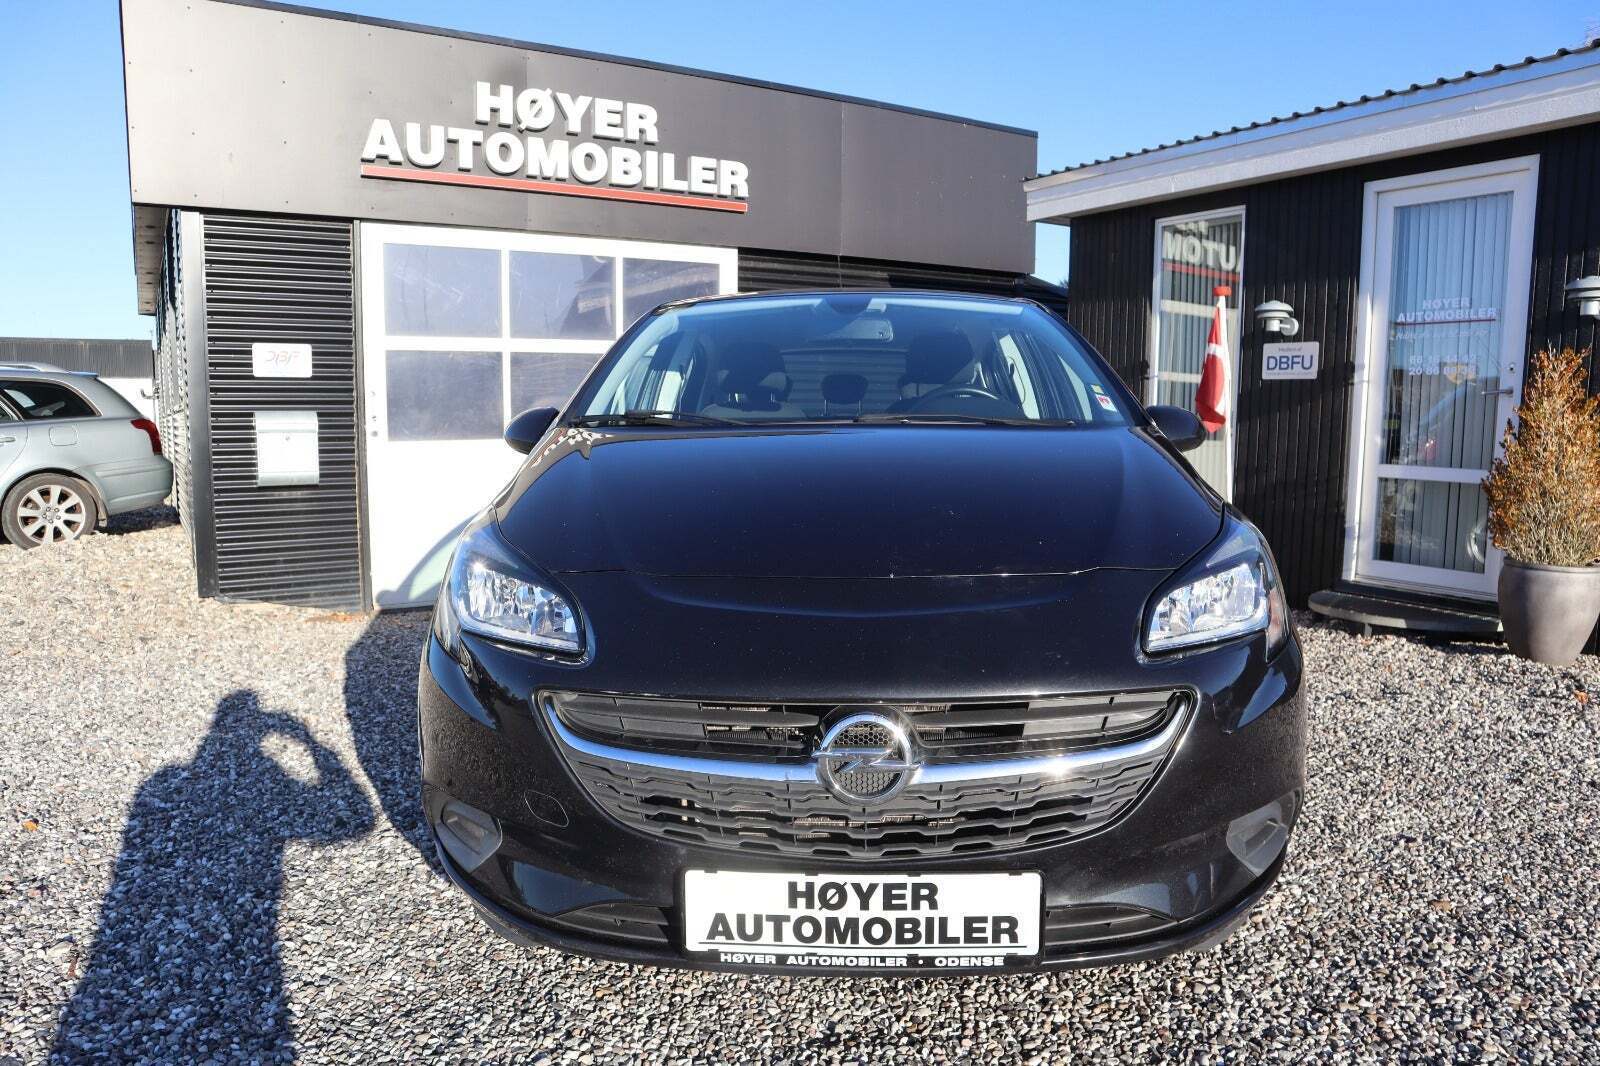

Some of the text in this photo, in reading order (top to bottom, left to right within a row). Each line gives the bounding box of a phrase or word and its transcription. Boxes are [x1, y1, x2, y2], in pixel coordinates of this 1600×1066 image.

[475, 80, 659, 144] HØYER
[361, 117, 750, 199] AUTOMOBILER
[1397, 307, 1497, 322] AUTOMOBILER
[1266, 354, 1314, 371] DBFU
[787, 881, 939, 912] HØYER
[705, 912, 1019, 946] AUTOMOBILER
[720, 952, 1005, 968] HØYER AUTOMOBILER ODENSE
